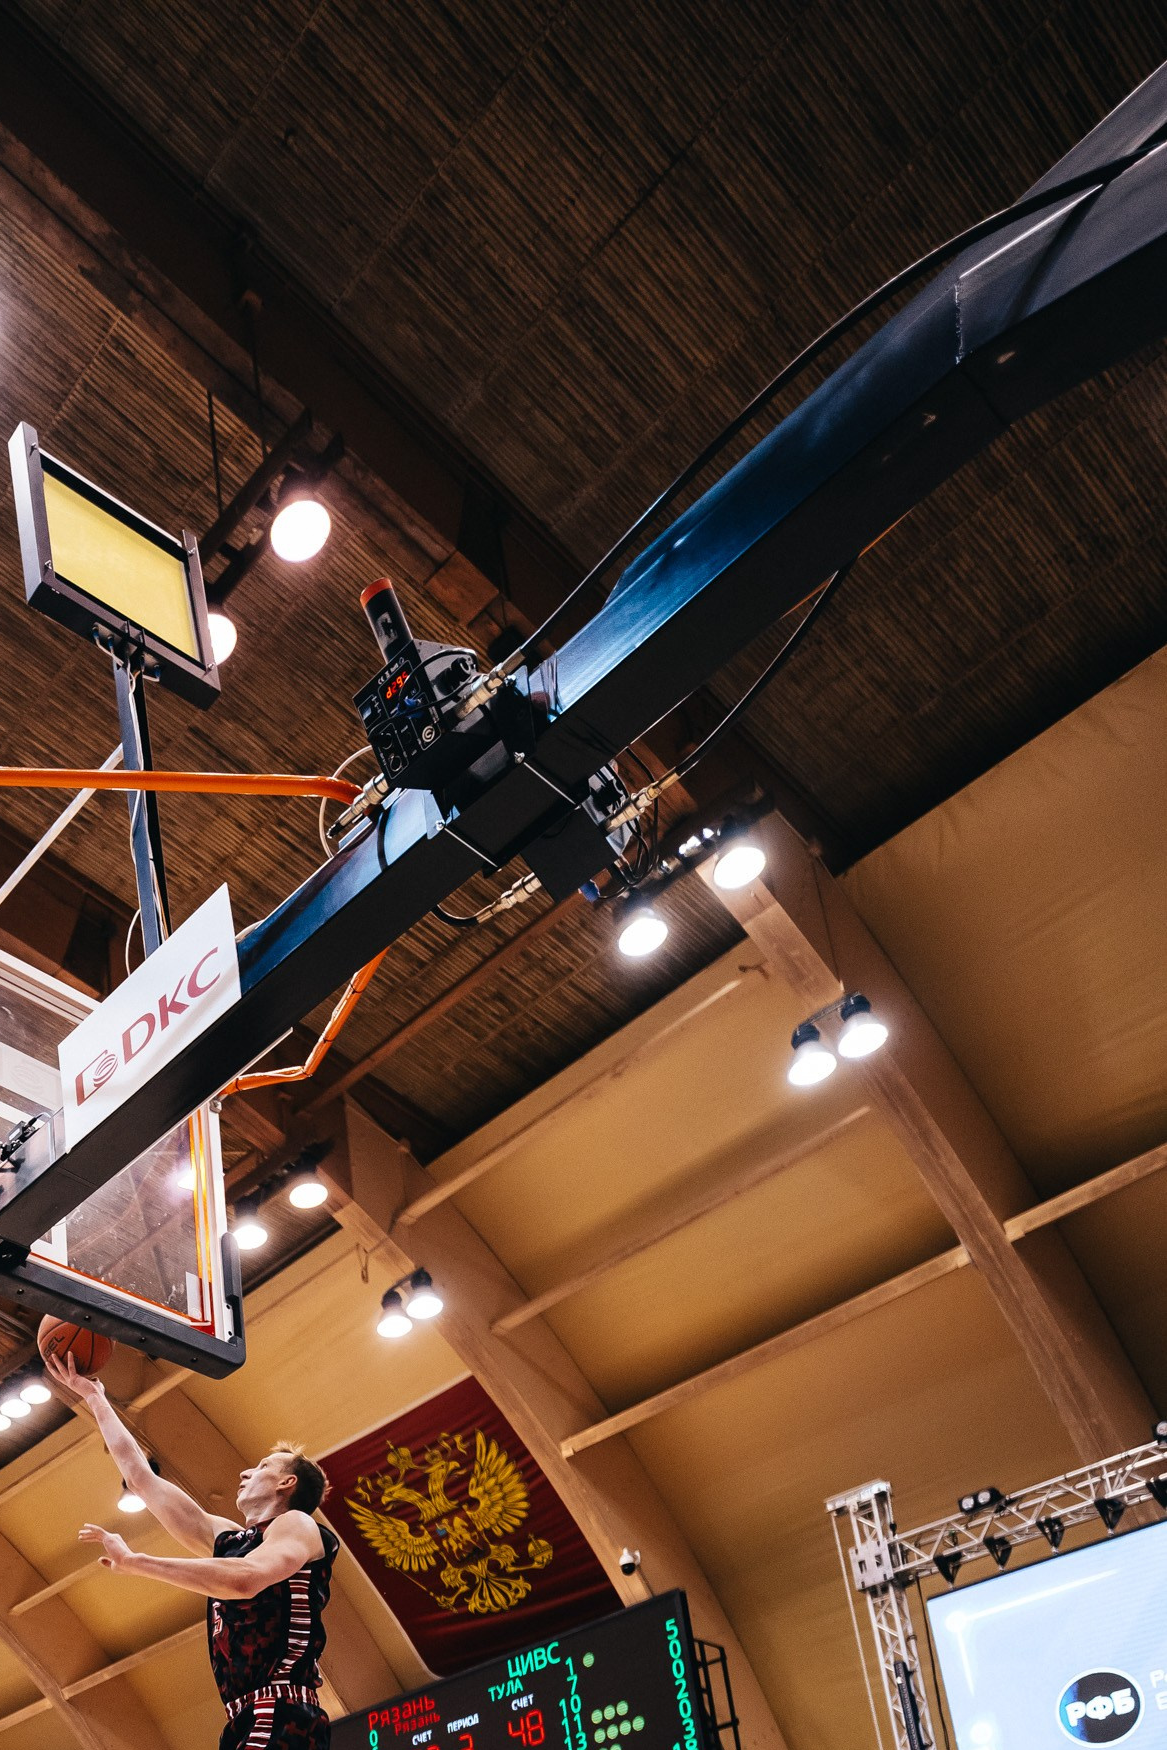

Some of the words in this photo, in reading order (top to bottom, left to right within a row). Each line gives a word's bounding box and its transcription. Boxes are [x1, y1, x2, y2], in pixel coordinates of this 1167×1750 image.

[122, 946, 221, 1066] DKC
[665, 1618, 679, 1641] 5
[507, 1641, 561, 1679] ЦИВС
[669, 1639, 682, 1660] 0
[566, 1657, 574, 1676] 1
[672, 1658, 685, 1679] 0
[488, 1678, 524, 1702] ТУЛА
[567, 1674, 578, 1695] 7
[675, 1678, 689, 1700] 2
[511, 1693, 534, 1711] СЧЕТ
[559, 1694, 582, 1718] 10
[679, 1698, 692, 1719] 0
[1065, 1687, 1135, 1728] РФБ
[446, 1713, 480, 1734] ПЕРИОД
[507, 1708, 545, 1747] 48
[562, 1712, 583, 1737] 11
[682, 1718, 695, 1740] 3
[369, 1729, 378, 1747] 0
[412, 1729, 433, 1746] СЧЕТ
